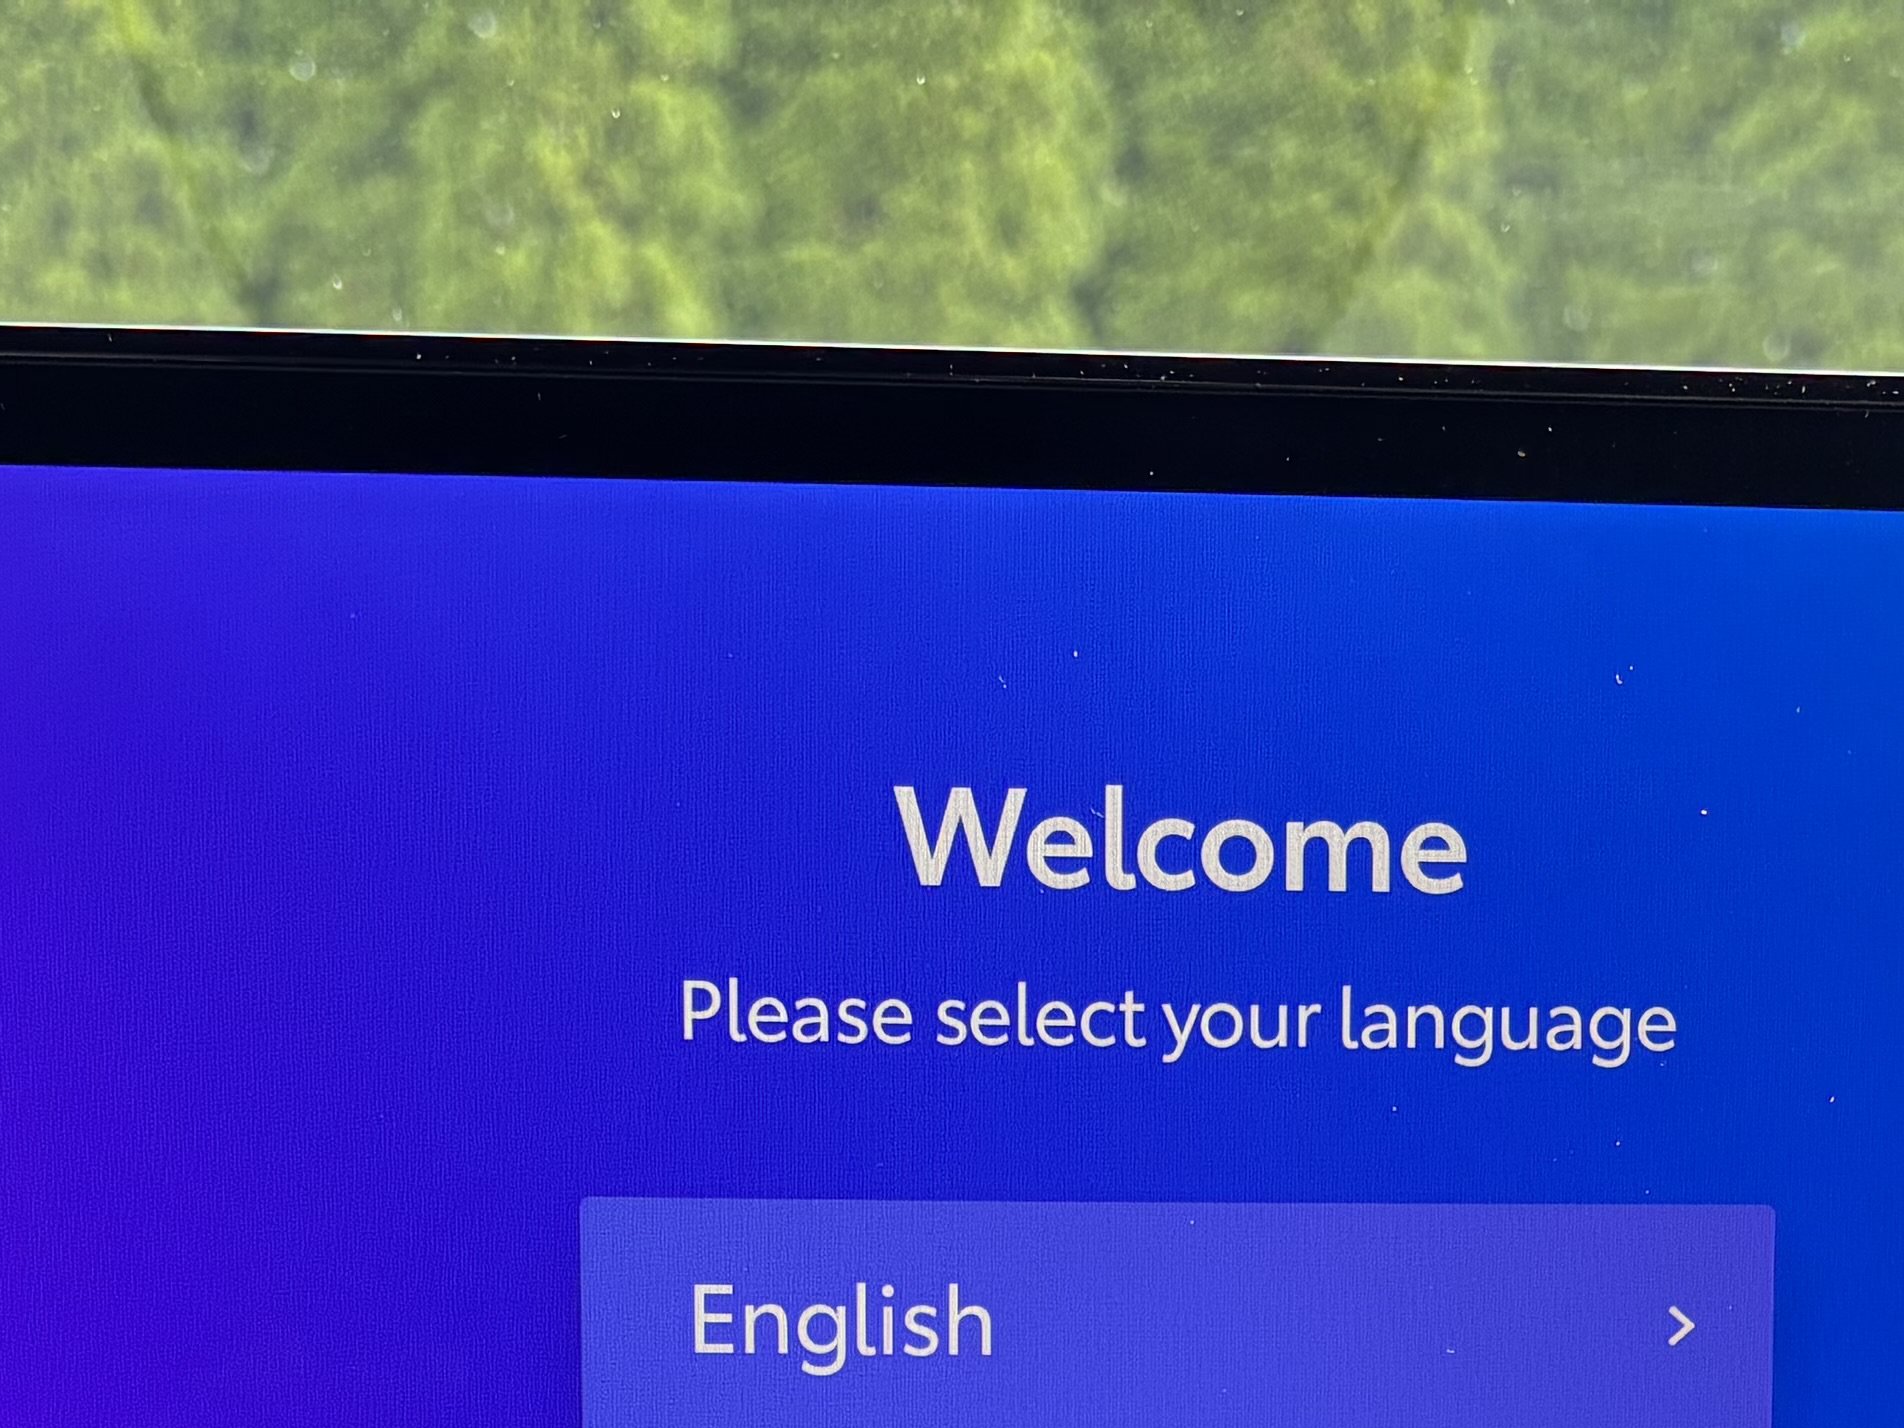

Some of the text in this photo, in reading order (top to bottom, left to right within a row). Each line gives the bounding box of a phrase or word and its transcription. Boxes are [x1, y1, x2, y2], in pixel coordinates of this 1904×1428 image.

[893, 784, 1468, 895] Welcome
[682, 977, 1677, 1068] Please select your language
[693, 1282, 994, 1376] English
